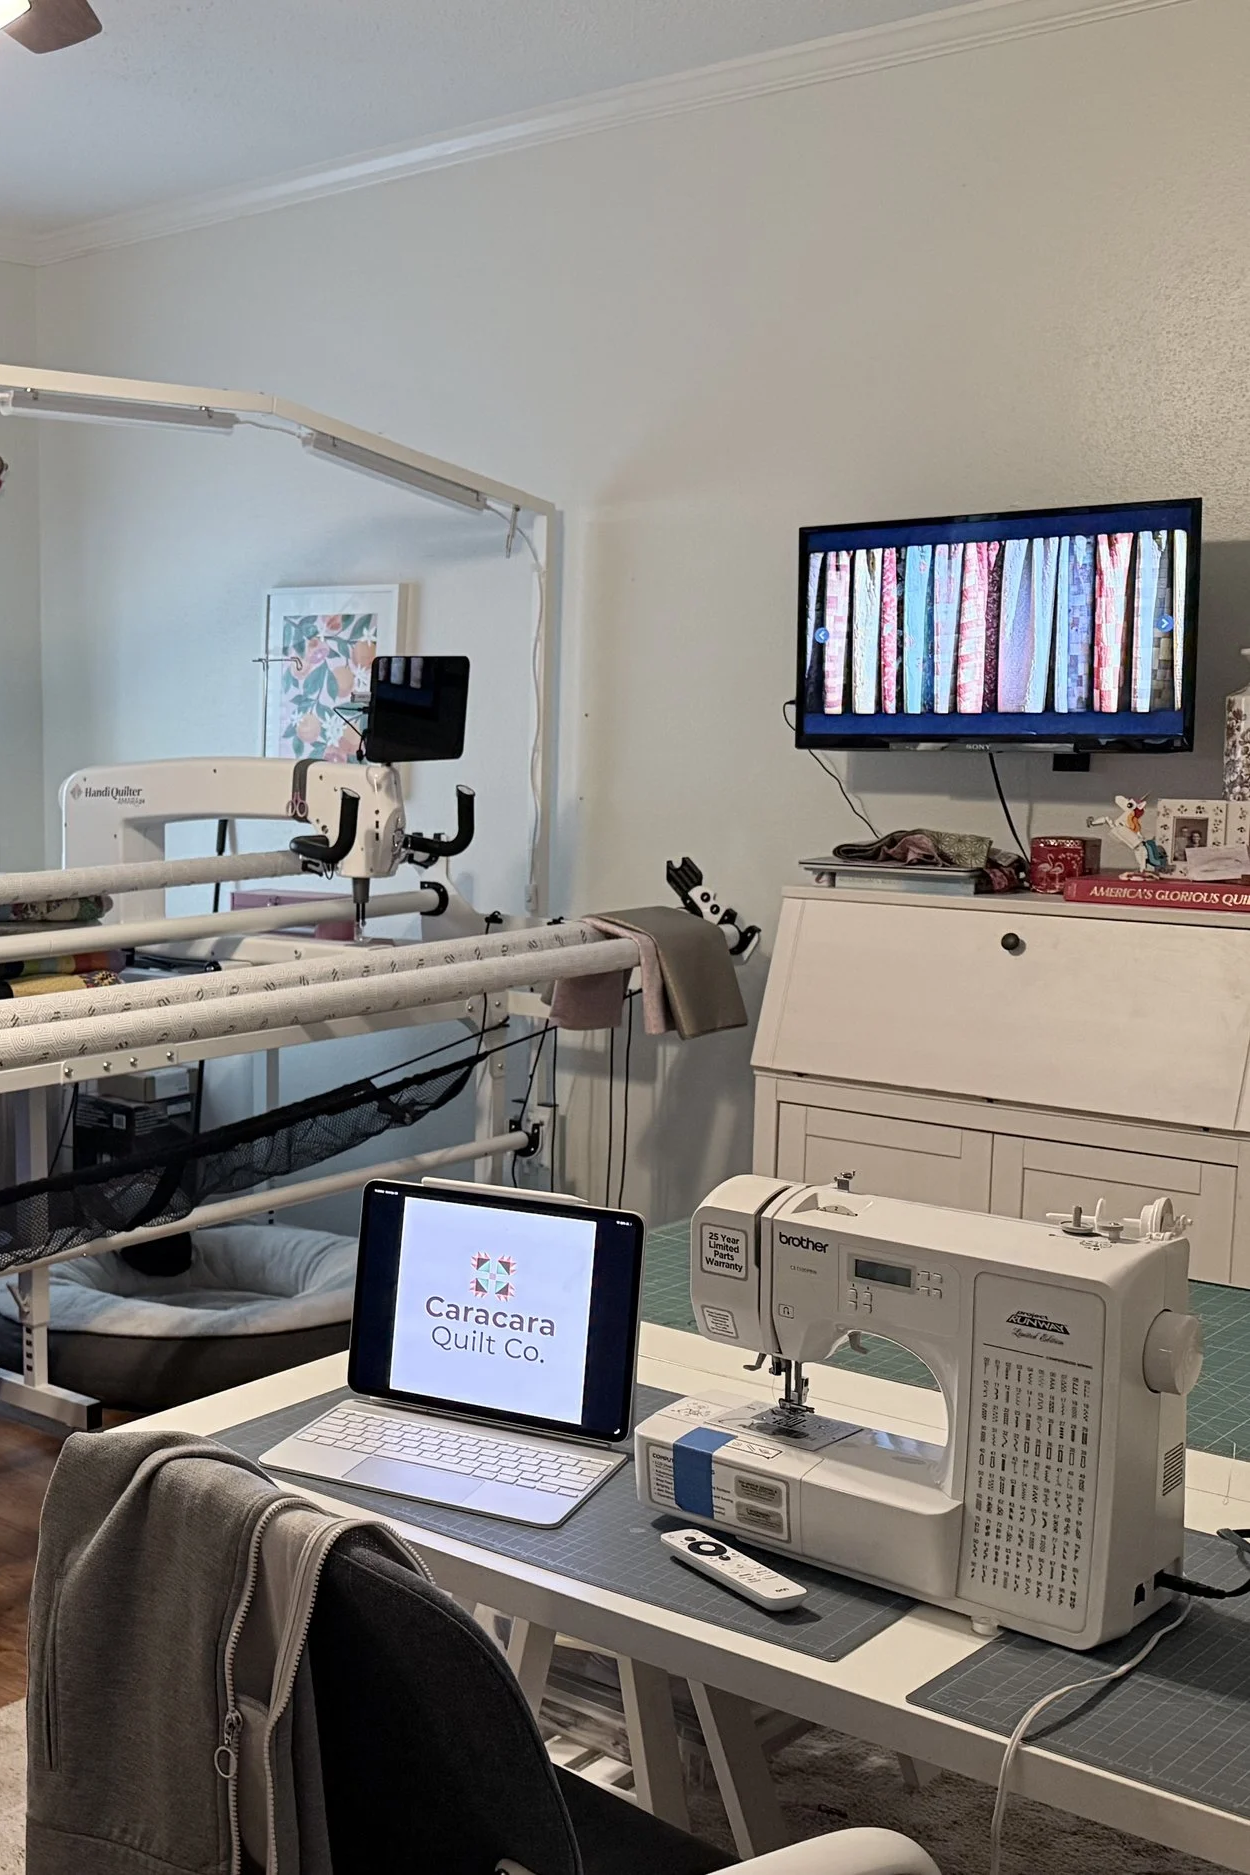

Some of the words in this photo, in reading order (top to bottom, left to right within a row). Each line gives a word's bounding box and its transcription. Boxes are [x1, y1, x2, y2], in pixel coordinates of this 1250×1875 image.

[1089, 886, 1153, 900] AMERICA'S
[1155, 889, 1220, 904] GLORIOUS
[708, 1231, 719, 1241] 25
[720, 1234, 740, 1245] Year
[708, 1240, 739, 1254] Limited
[779, 1232, 829, 1254] brother
[705, 1256, 743, 1273] Warranty
[713, 1250, 735, 1261] Parts
[425, 1295, 556, 1337] Caracara
[1008, 1314, 1066, 1334] RUNWAY
[431, 1325, 496, 1355] Quilt
[504, 1338, 545, 1364] Co.
